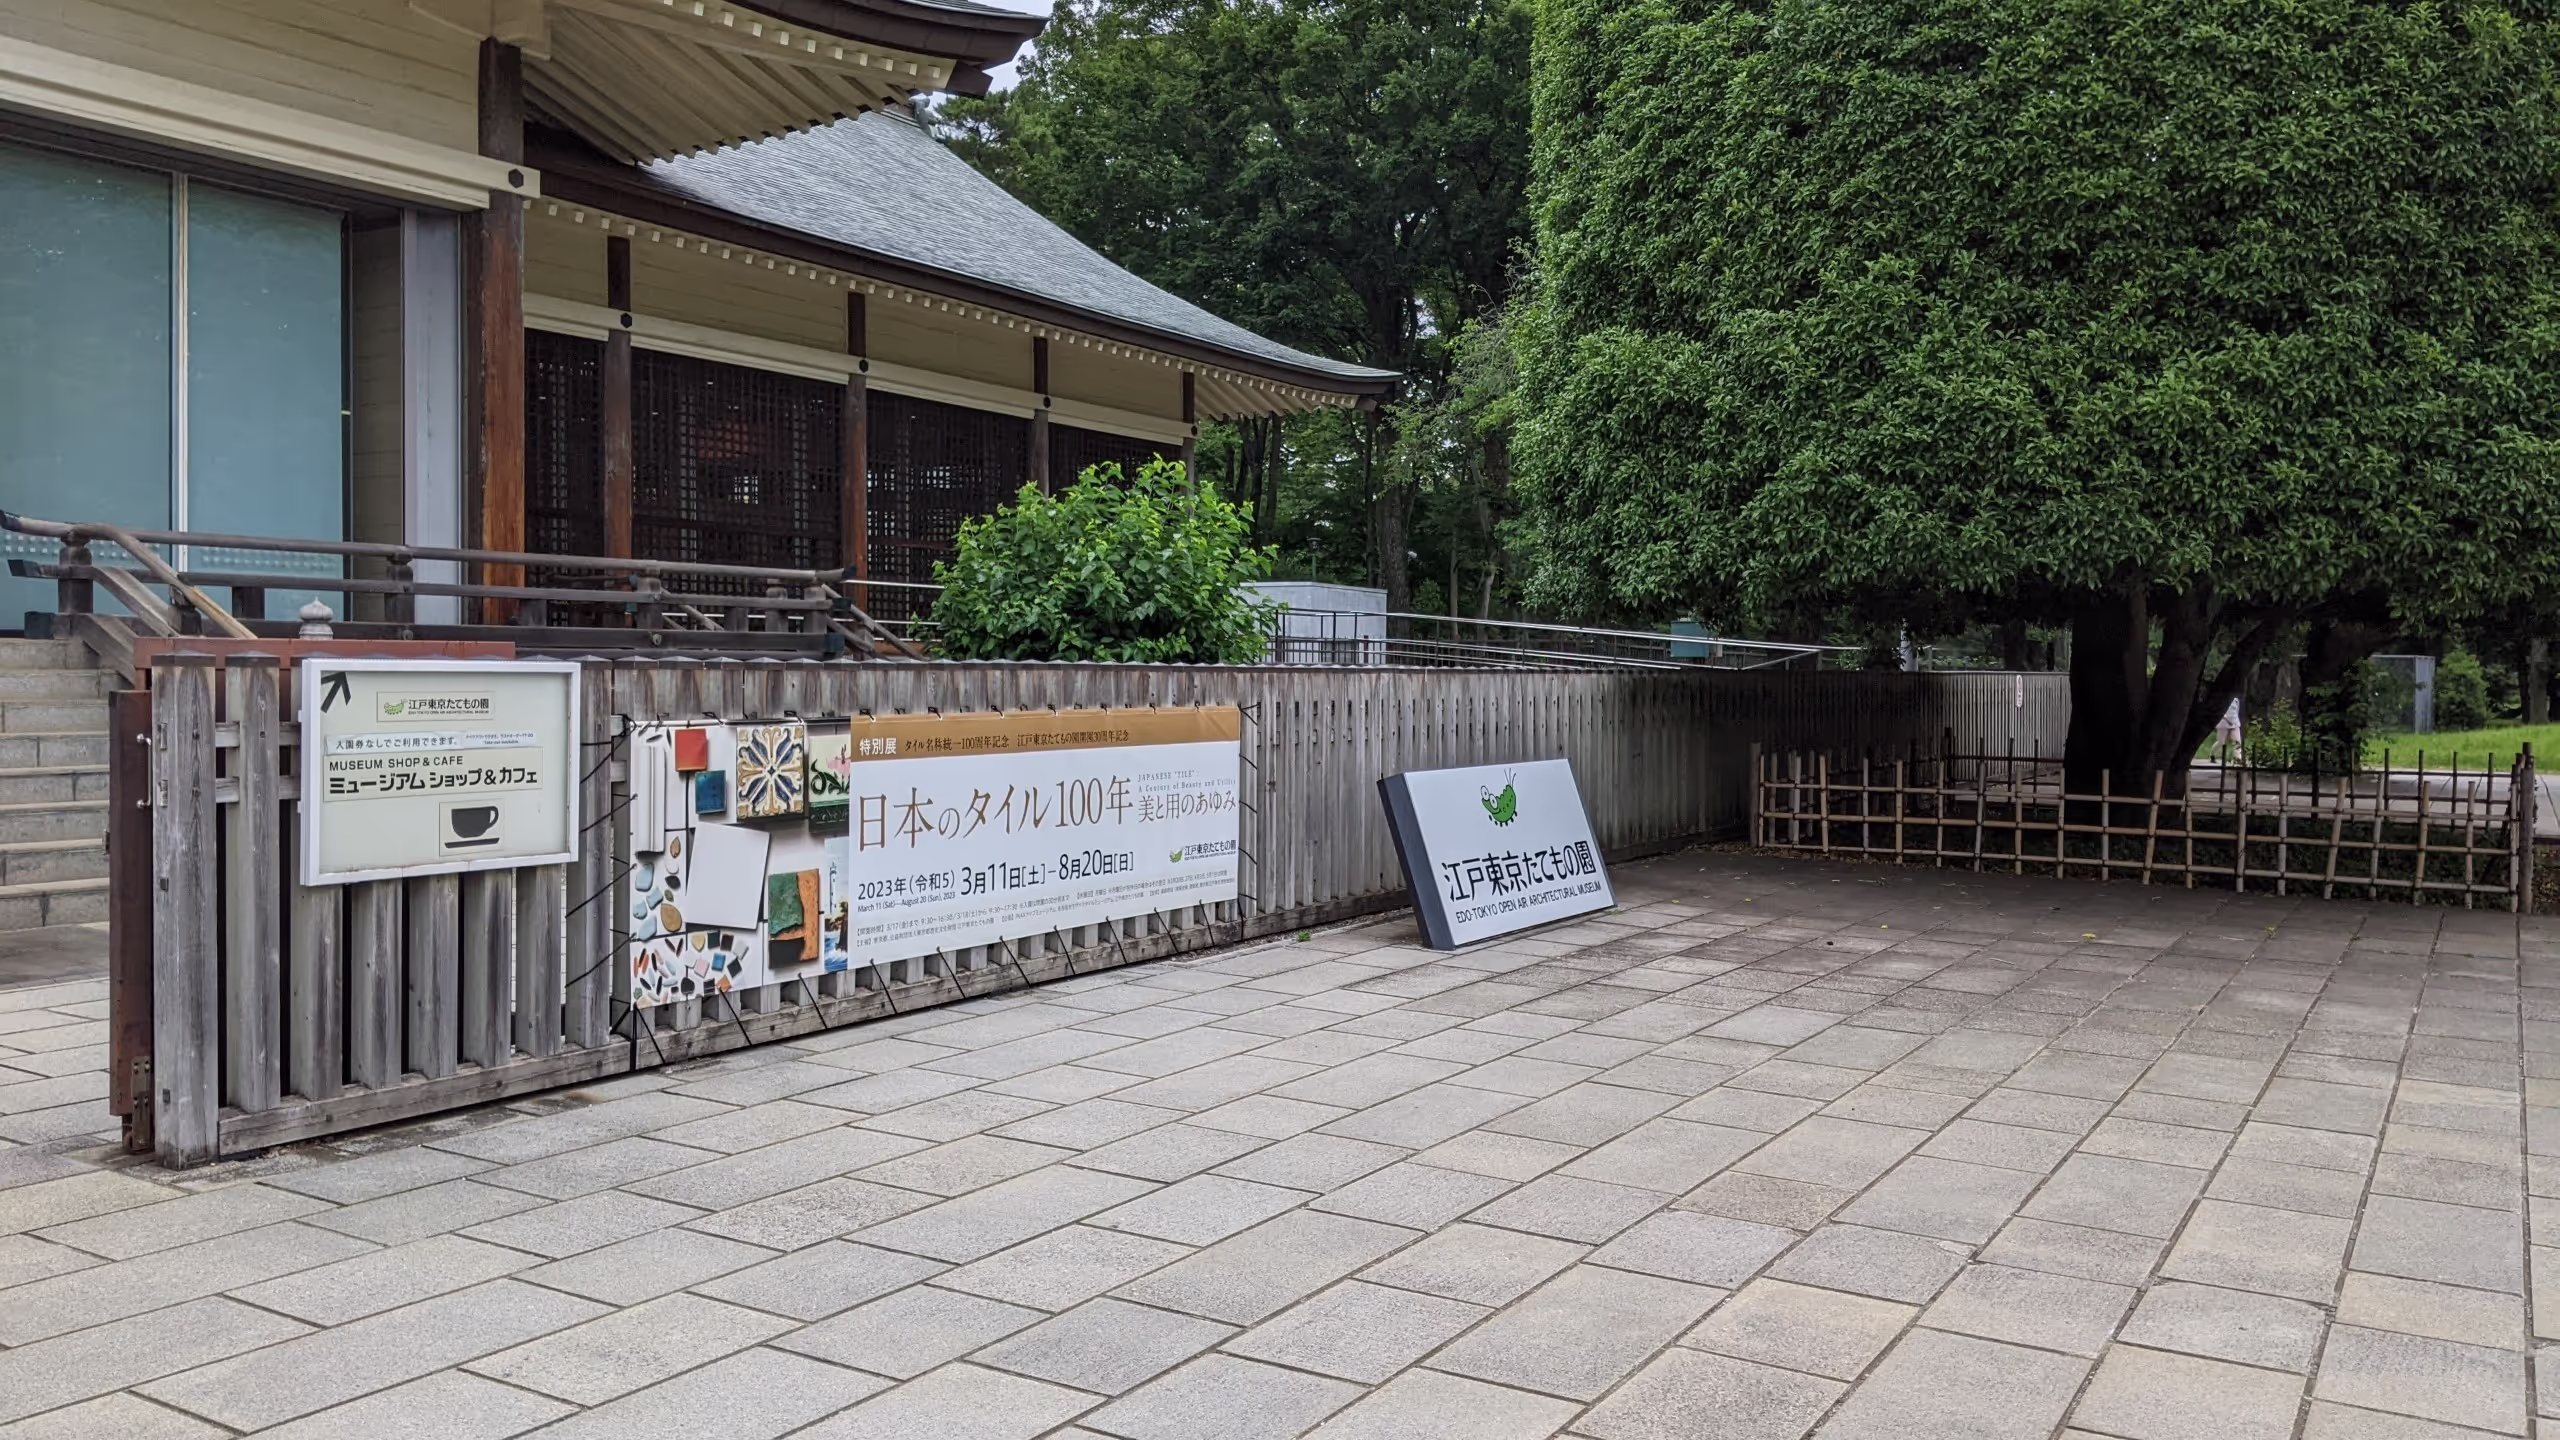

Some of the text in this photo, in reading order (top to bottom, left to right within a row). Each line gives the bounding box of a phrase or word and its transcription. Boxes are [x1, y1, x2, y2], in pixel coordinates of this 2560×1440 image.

[408, 698, 489, 710] 江戸東京たてもの園
[336, 735, 458, 750] 入園券なしでご利用できます。
[859, 737, 896, 756] 特別展
[329, 756, 463, 772] MUSEUM SHOP & CAFE
[1138, 772, 1172, 782] JAPANESE
[859, 774, 1134, 852] 日本のタイル100年
[1138, 790, 1236, 823] 美と用のあゆみ
[1441, 840, 1597, 902] 江戸東京たてもの園
[858, 869, 955, 900] 2023年(令和5)
[858, 904, 874, 912] March
[876, 902, 881, 910] 11
[920, 896, 927, 904] 20
[943, 891, 955, 900] 2023
[1455, 881, 1602, 924] EDO-TOKYO OPEN AIR ARCHITECTURAL MUSEUM
